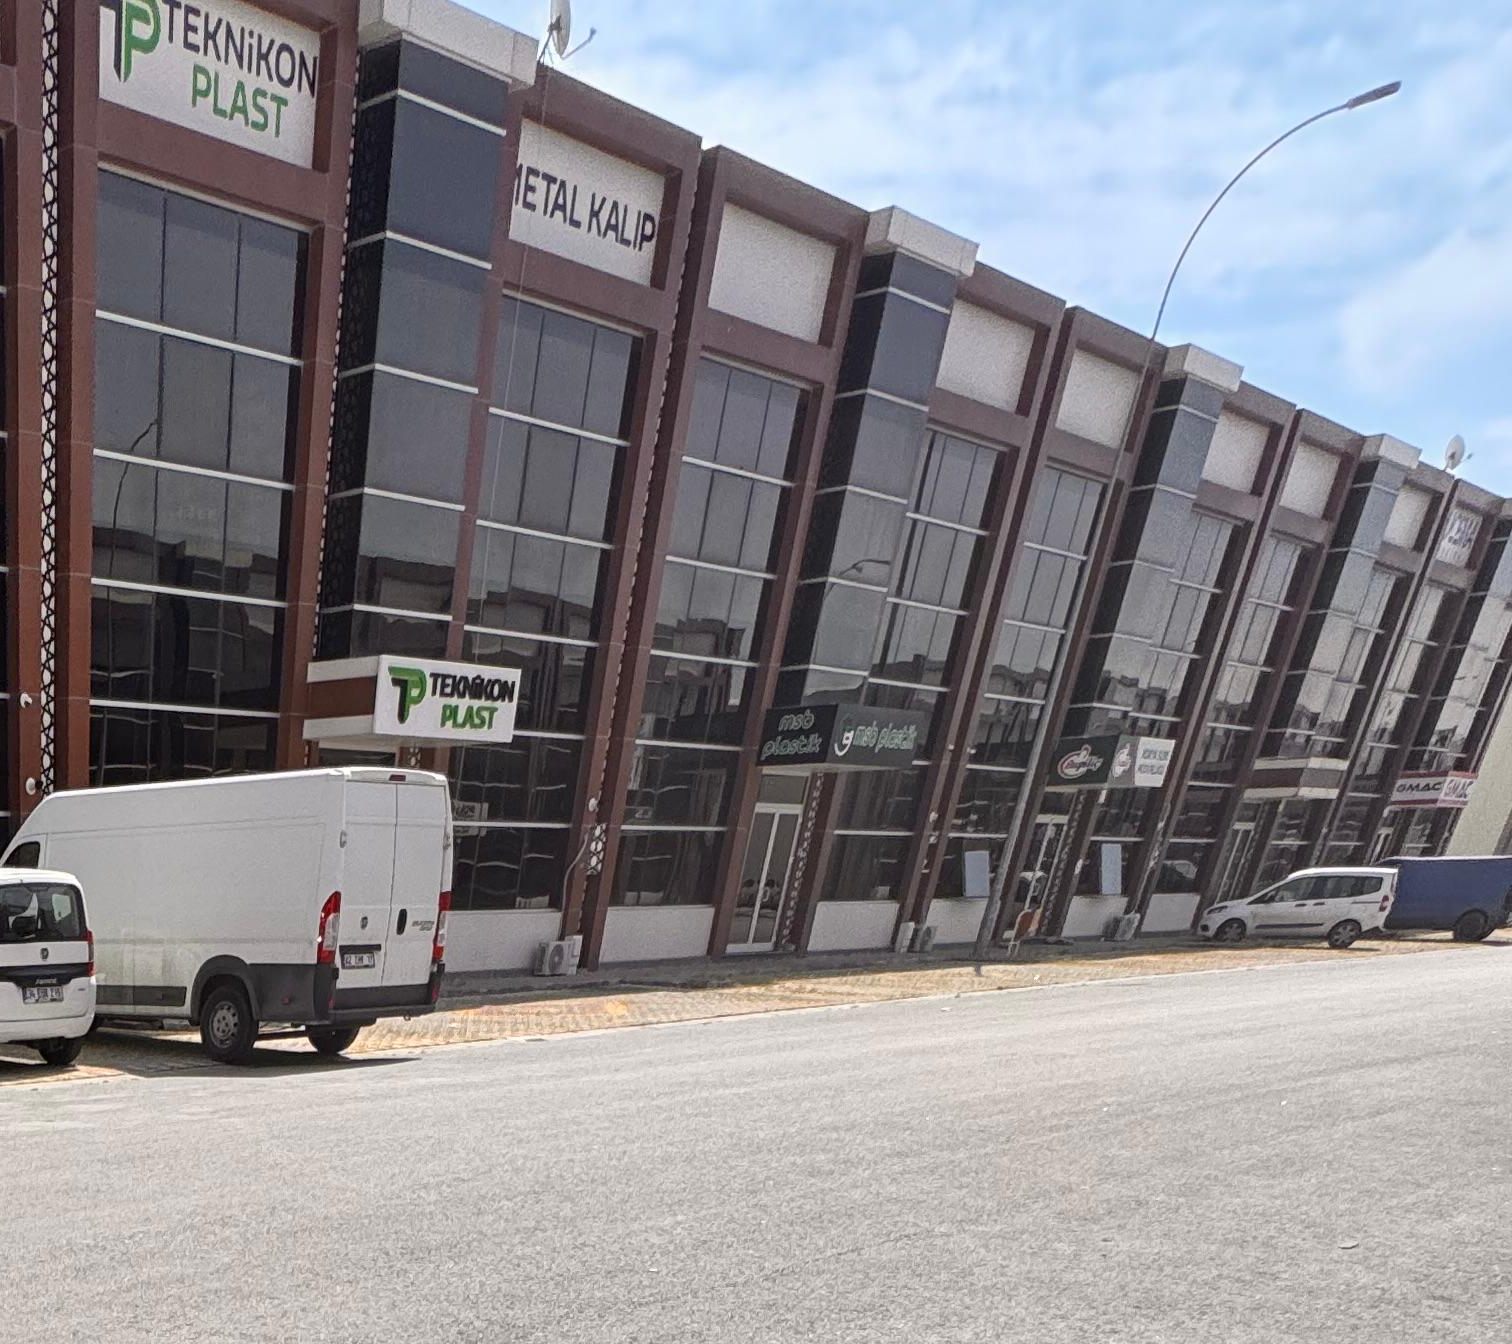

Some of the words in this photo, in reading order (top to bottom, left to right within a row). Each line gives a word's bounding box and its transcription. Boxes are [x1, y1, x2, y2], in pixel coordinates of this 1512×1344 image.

[191, 63, 288, 138] PLAST
[588, 192, 656, 251] KALIP
[440, 704, 498, 729] PLAST
